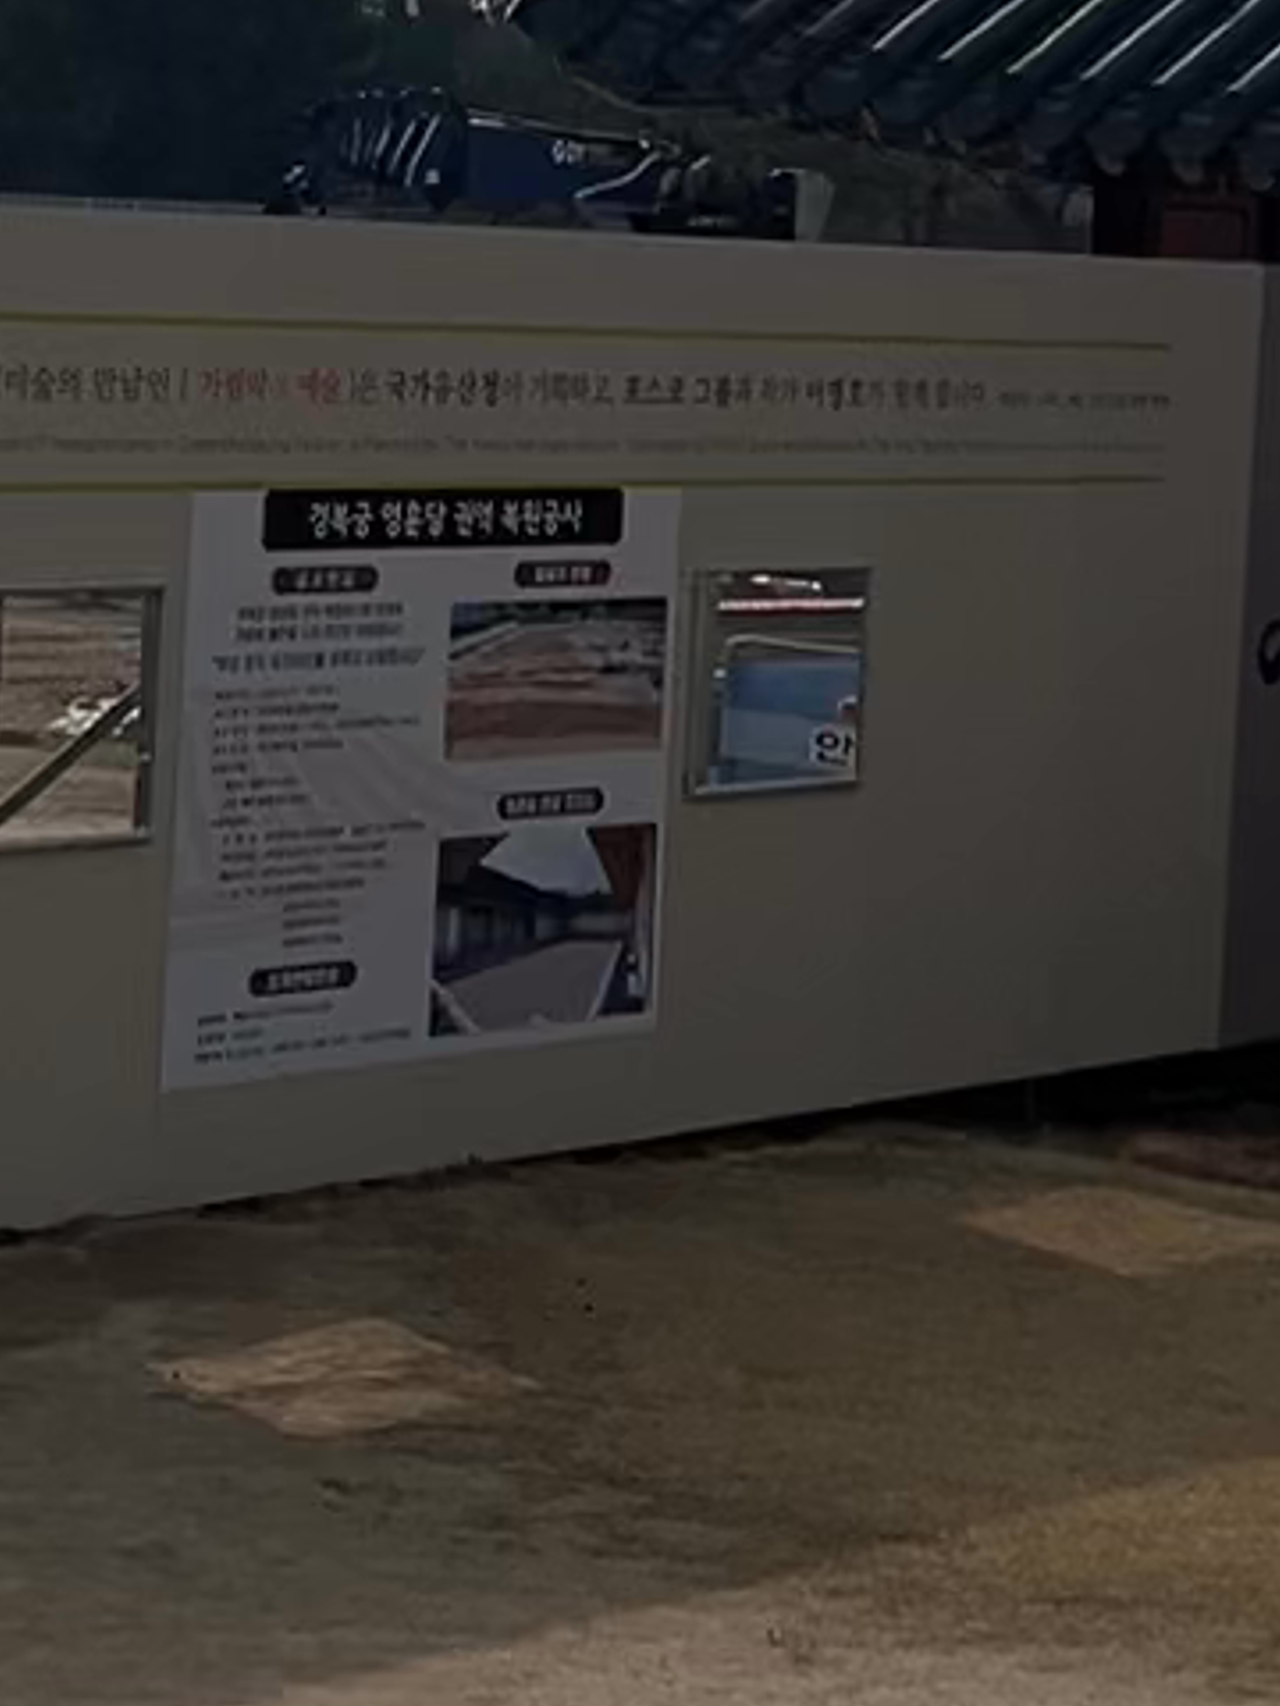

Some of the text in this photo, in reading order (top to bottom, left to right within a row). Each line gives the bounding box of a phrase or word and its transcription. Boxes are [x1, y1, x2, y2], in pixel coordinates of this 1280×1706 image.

[93, 366, 171, 404] 만남인
[622, 373, 685, 406] 포스코
[308, 500, 373, 539] 경복궁
[500, 498, 583, 537] 복원공사
